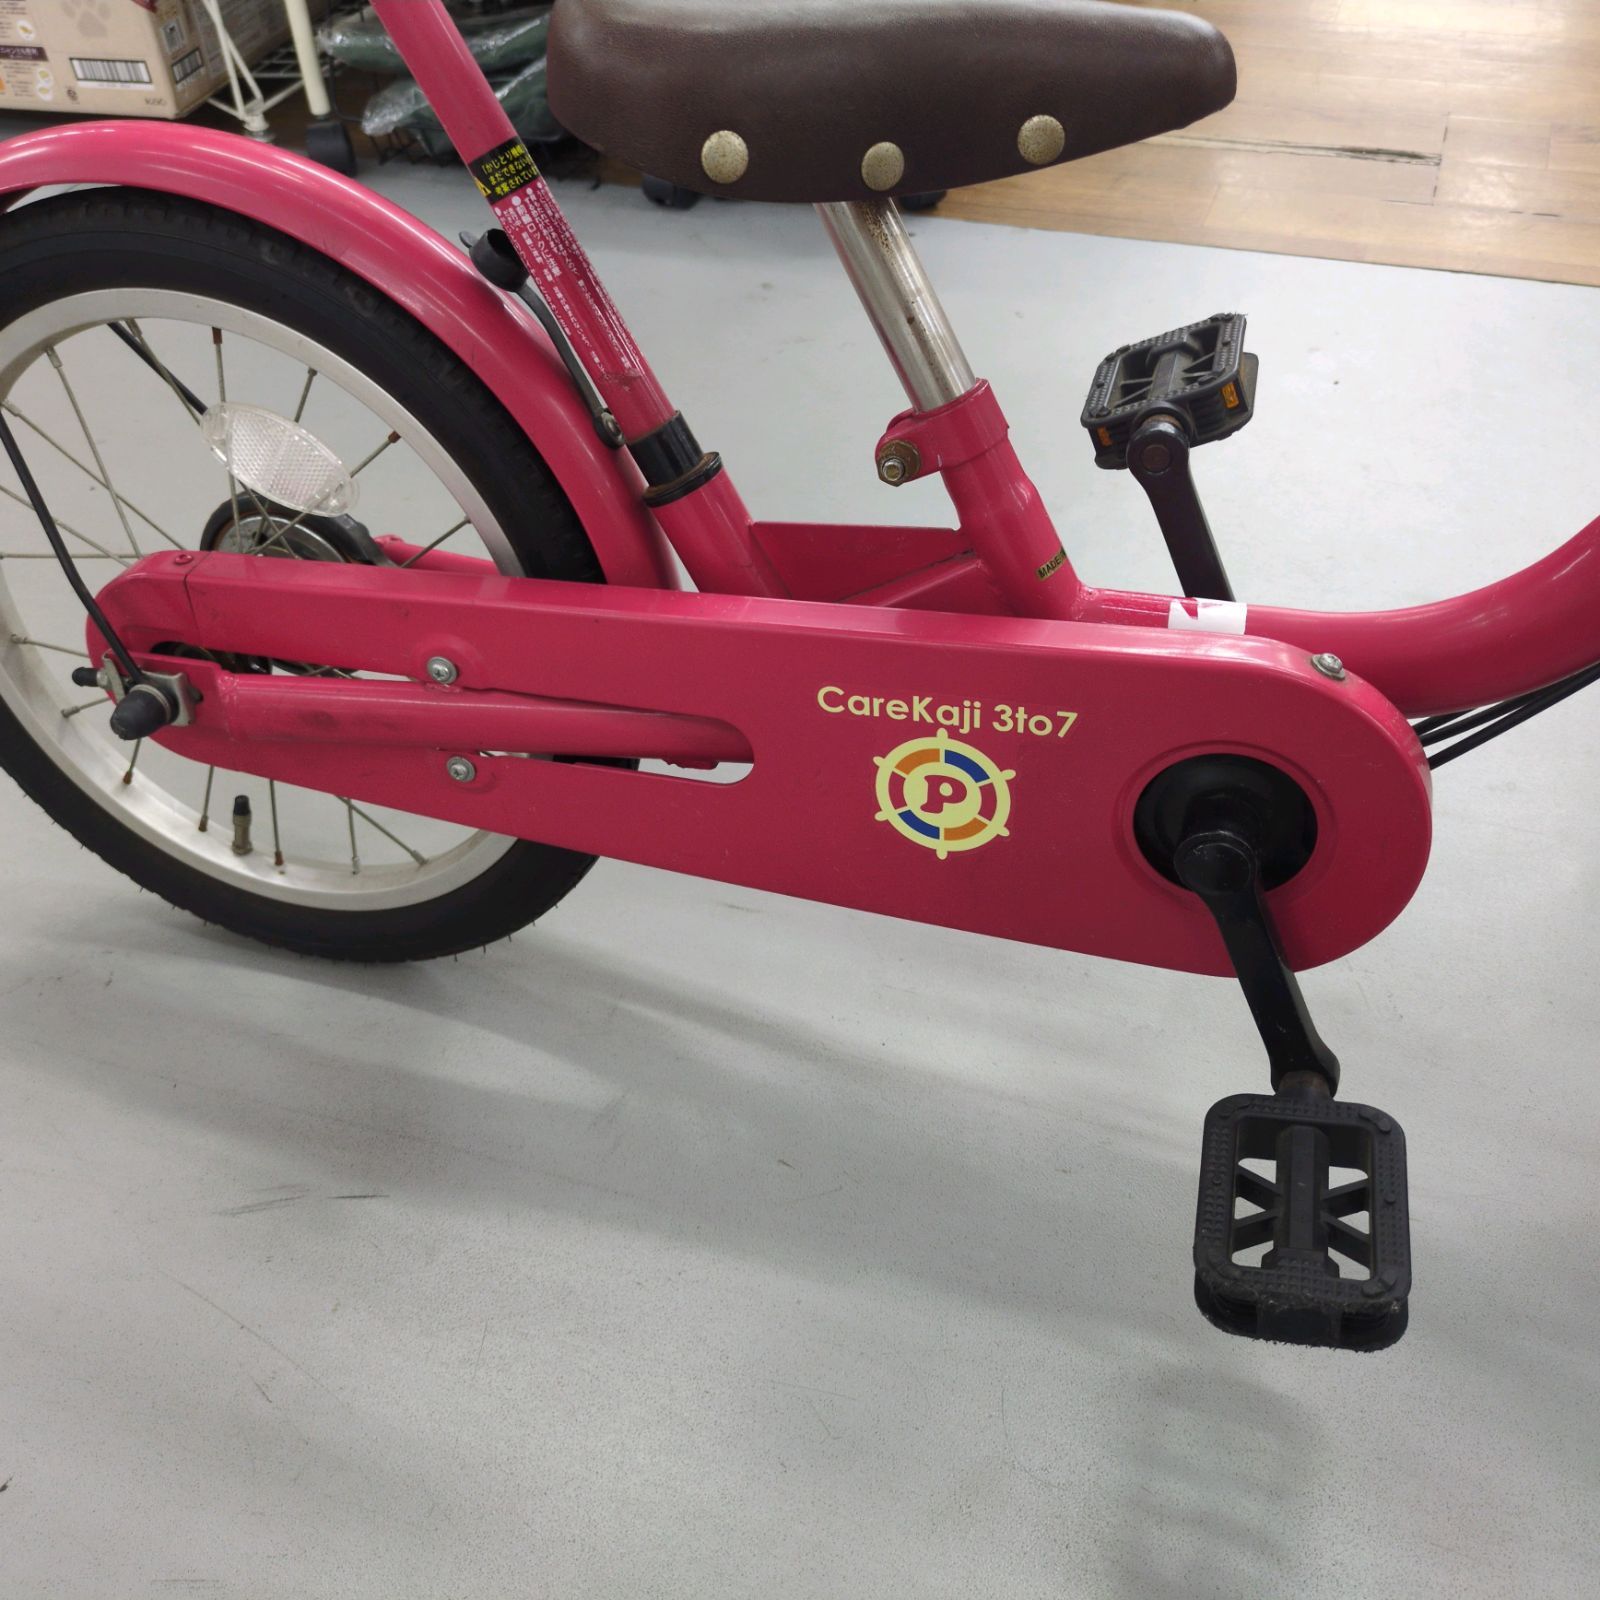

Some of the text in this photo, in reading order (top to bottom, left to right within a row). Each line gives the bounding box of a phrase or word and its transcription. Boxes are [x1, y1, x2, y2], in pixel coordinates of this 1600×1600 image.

[1038, 555, 1062, 578] MADE
[817, 686, 1079, 738] CareKaji 3to7
[920, 775, 967, 814] P
